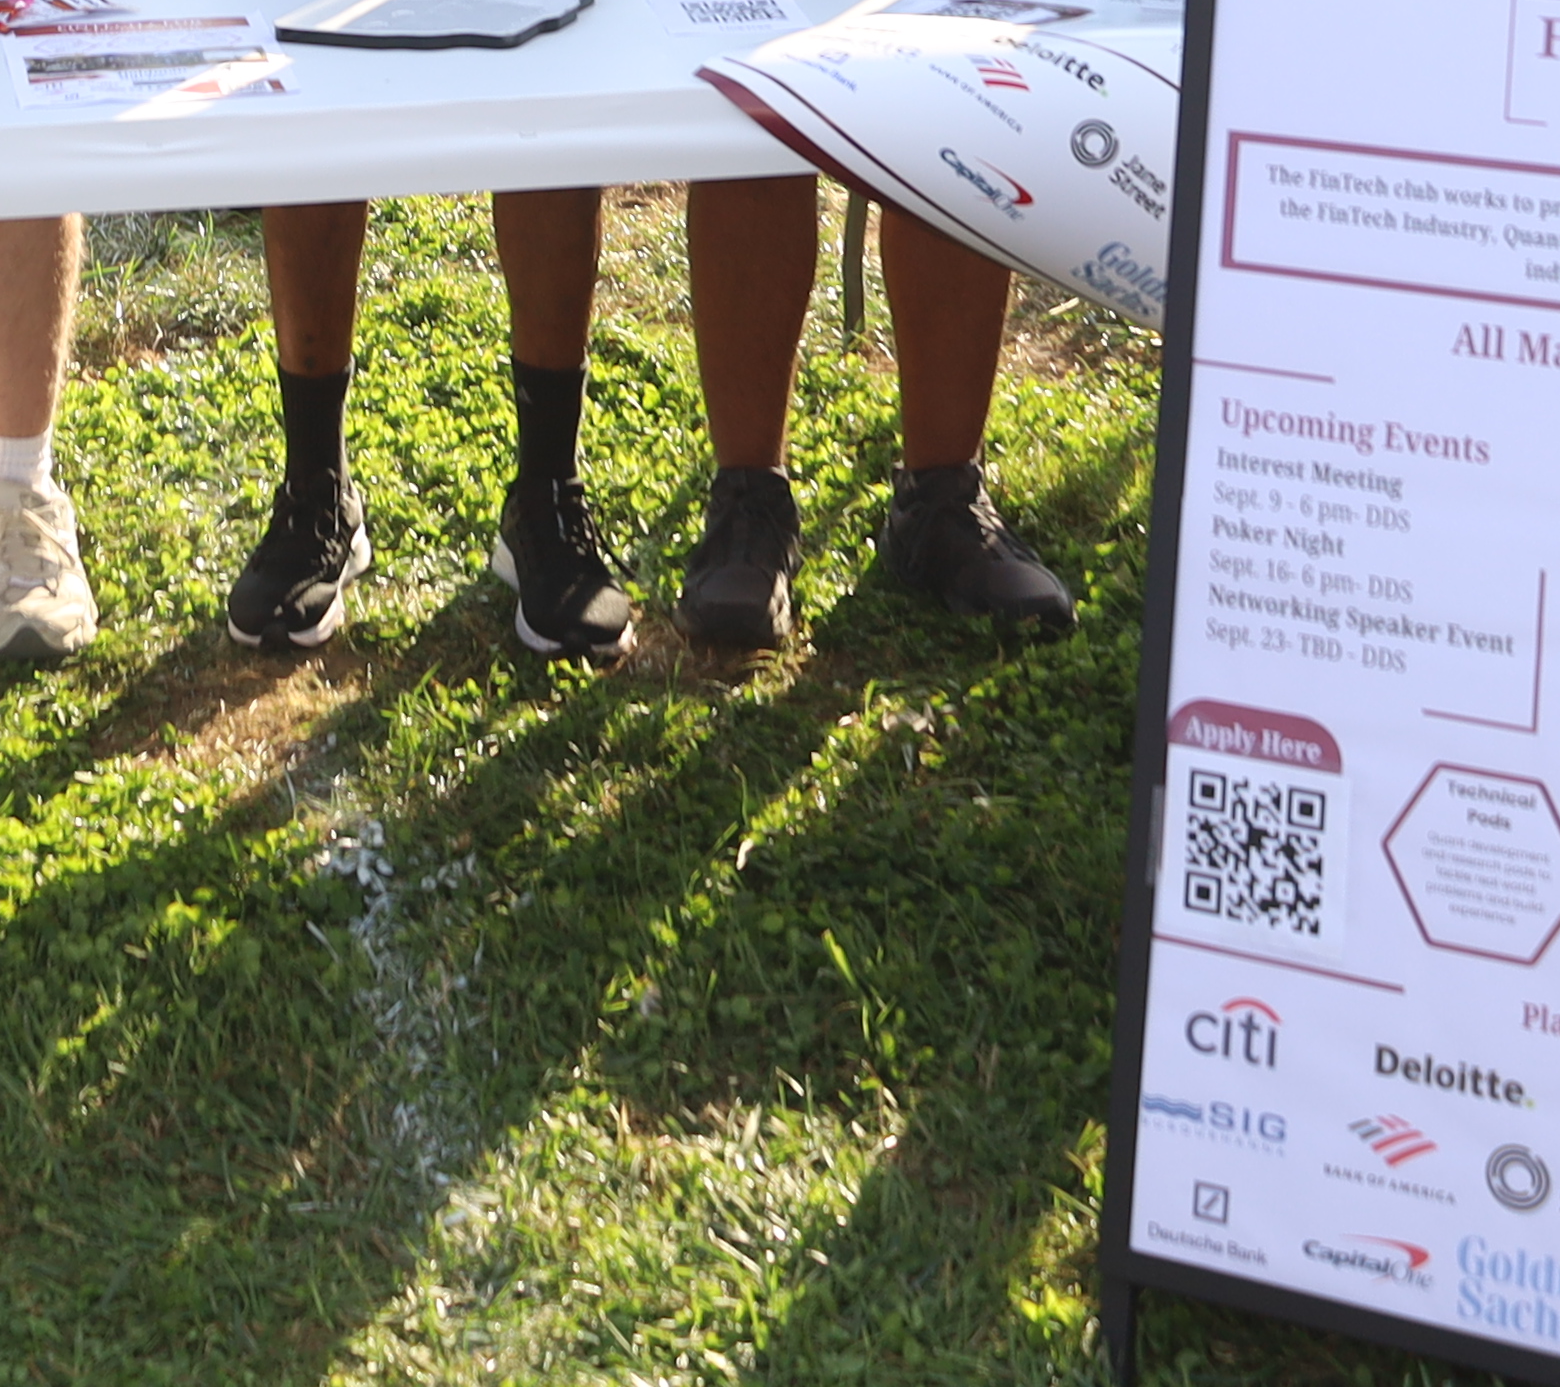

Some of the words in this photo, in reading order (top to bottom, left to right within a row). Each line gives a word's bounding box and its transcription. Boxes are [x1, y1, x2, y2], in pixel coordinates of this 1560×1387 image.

[1108, 171, 1168, 222] Street
[1124, 154, 1169, 196] Jane
[1071, 259, 1158, 320] Sachs
[1452, 323, 1504, 360] All
[1221, 397, 1374, 454] Upcoming
[1384, 421, 1489, 463] Events
[1185, 715, 1256, 756] Apply
[1259, 728, 1321, 765] Here
[1184, 1004, 1279, 1068] citi
[1373, 1042, 1536, 1109] Deloitte.
[1209, 1101, 1286, 1142] SIG
